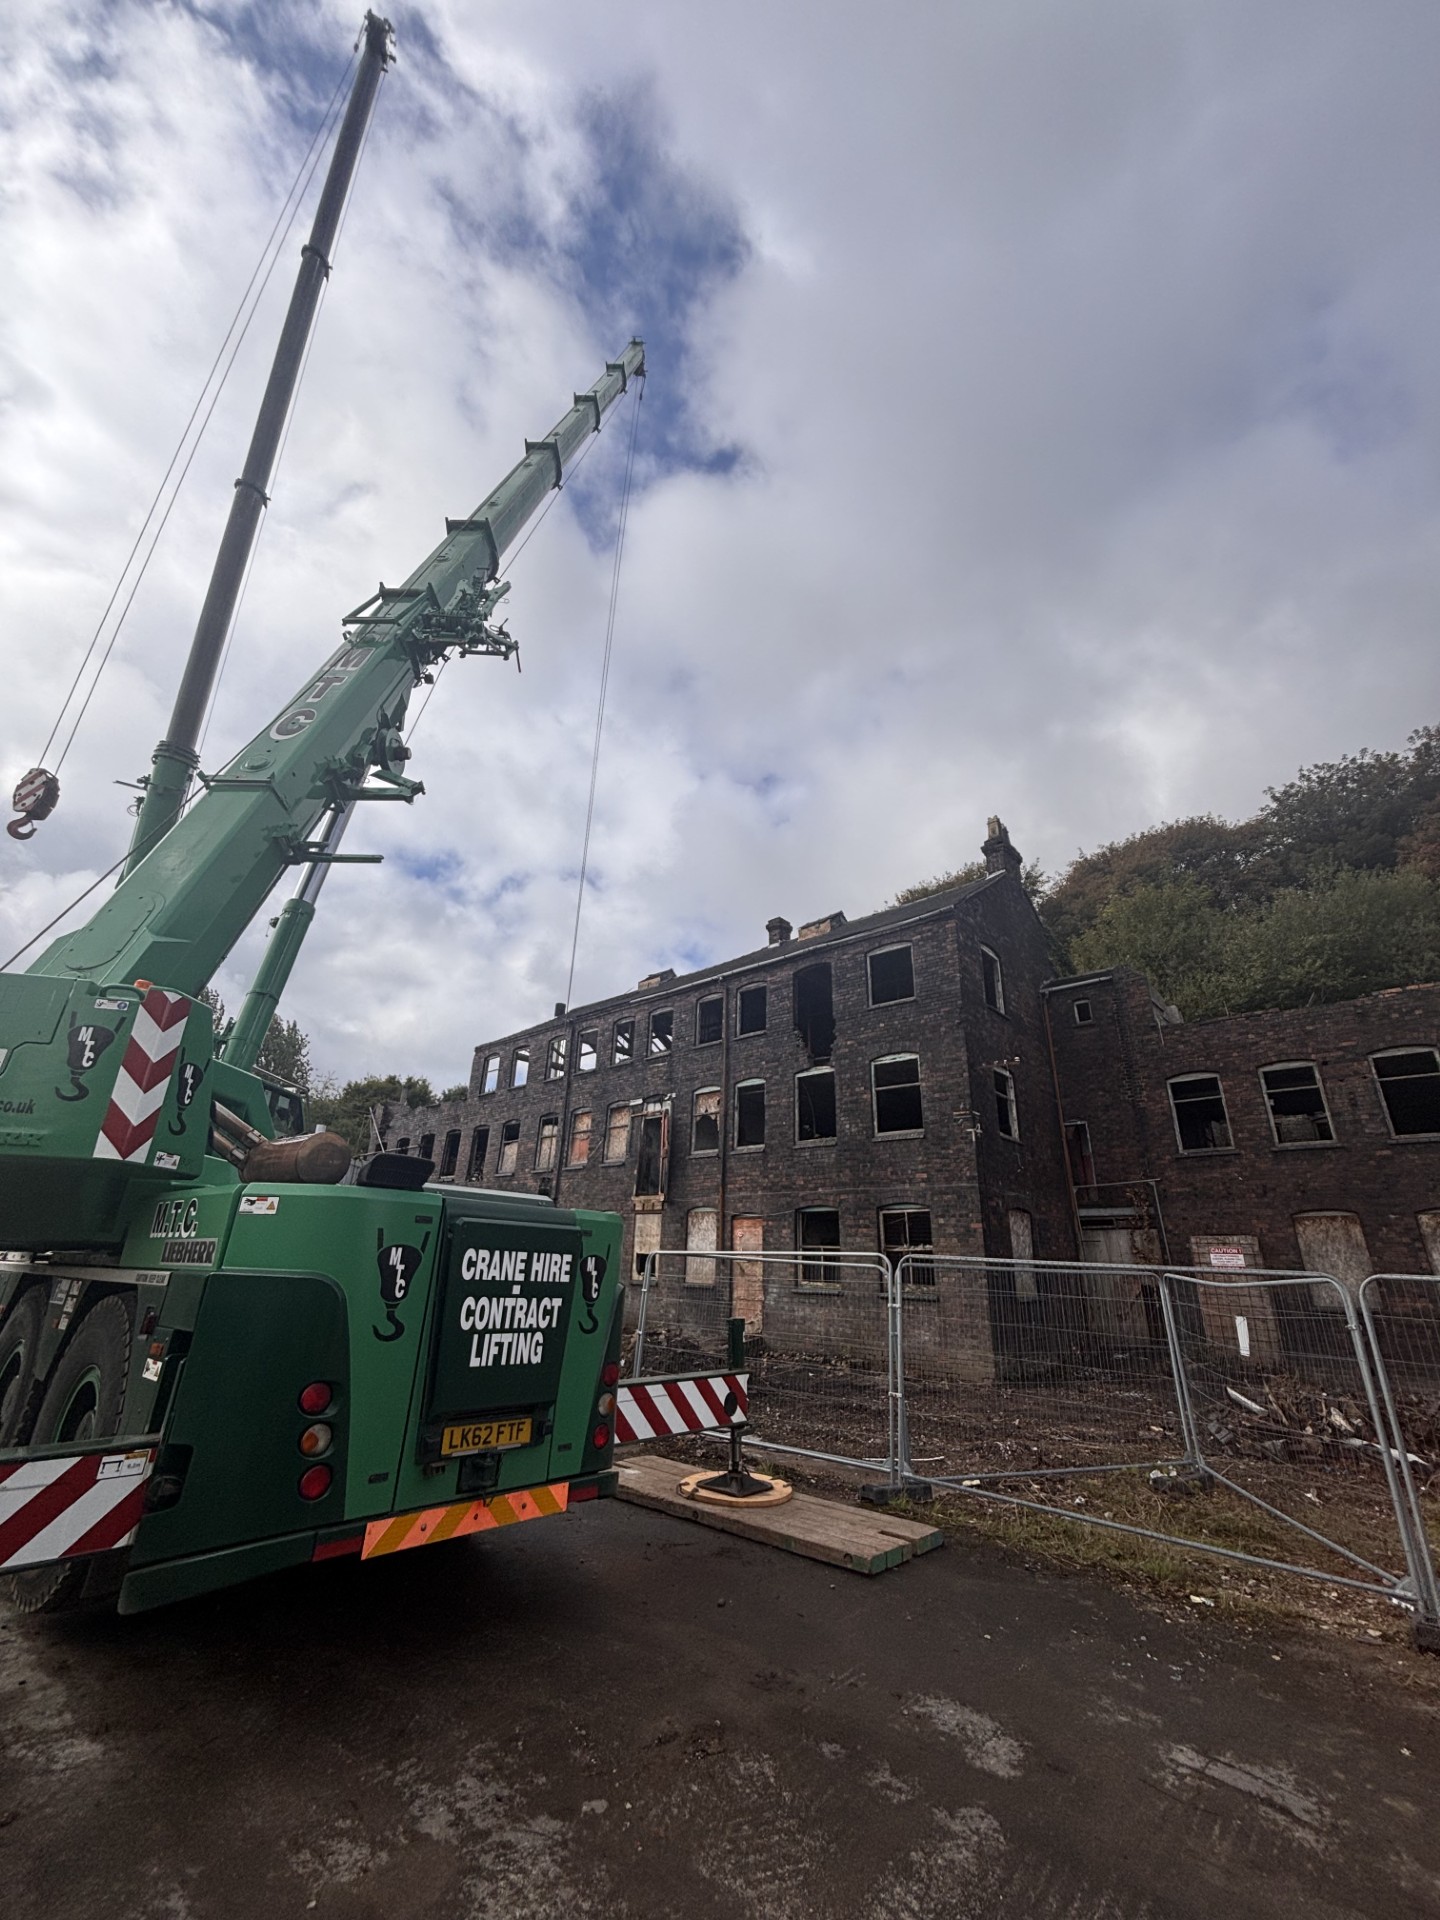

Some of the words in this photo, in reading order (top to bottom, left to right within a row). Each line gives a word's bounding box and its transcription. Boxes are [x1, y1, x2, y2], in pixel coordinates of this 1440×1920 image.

[77, 1026, 96, 1068] MTC
[184, 1064, 194, 1105] MTC
[149, 1198, 198, 1238] M.T.C.
[161, 1240, 216, 1264] LIEBHERR
[461, 1247, 528, 1281] CRANE
[530, 1252, 572, 1282] HIRE
[388, 1246, 406, 1299] MTC
[586, 1256, 599, 1299] MTC
[460, 1296, 563, 1331] CONTRACT
[469, 1331, 544, 1368] LIFTING
[449, 1426, 493, 1449] LK62
[496, 1421, 526, 1443] FTF
